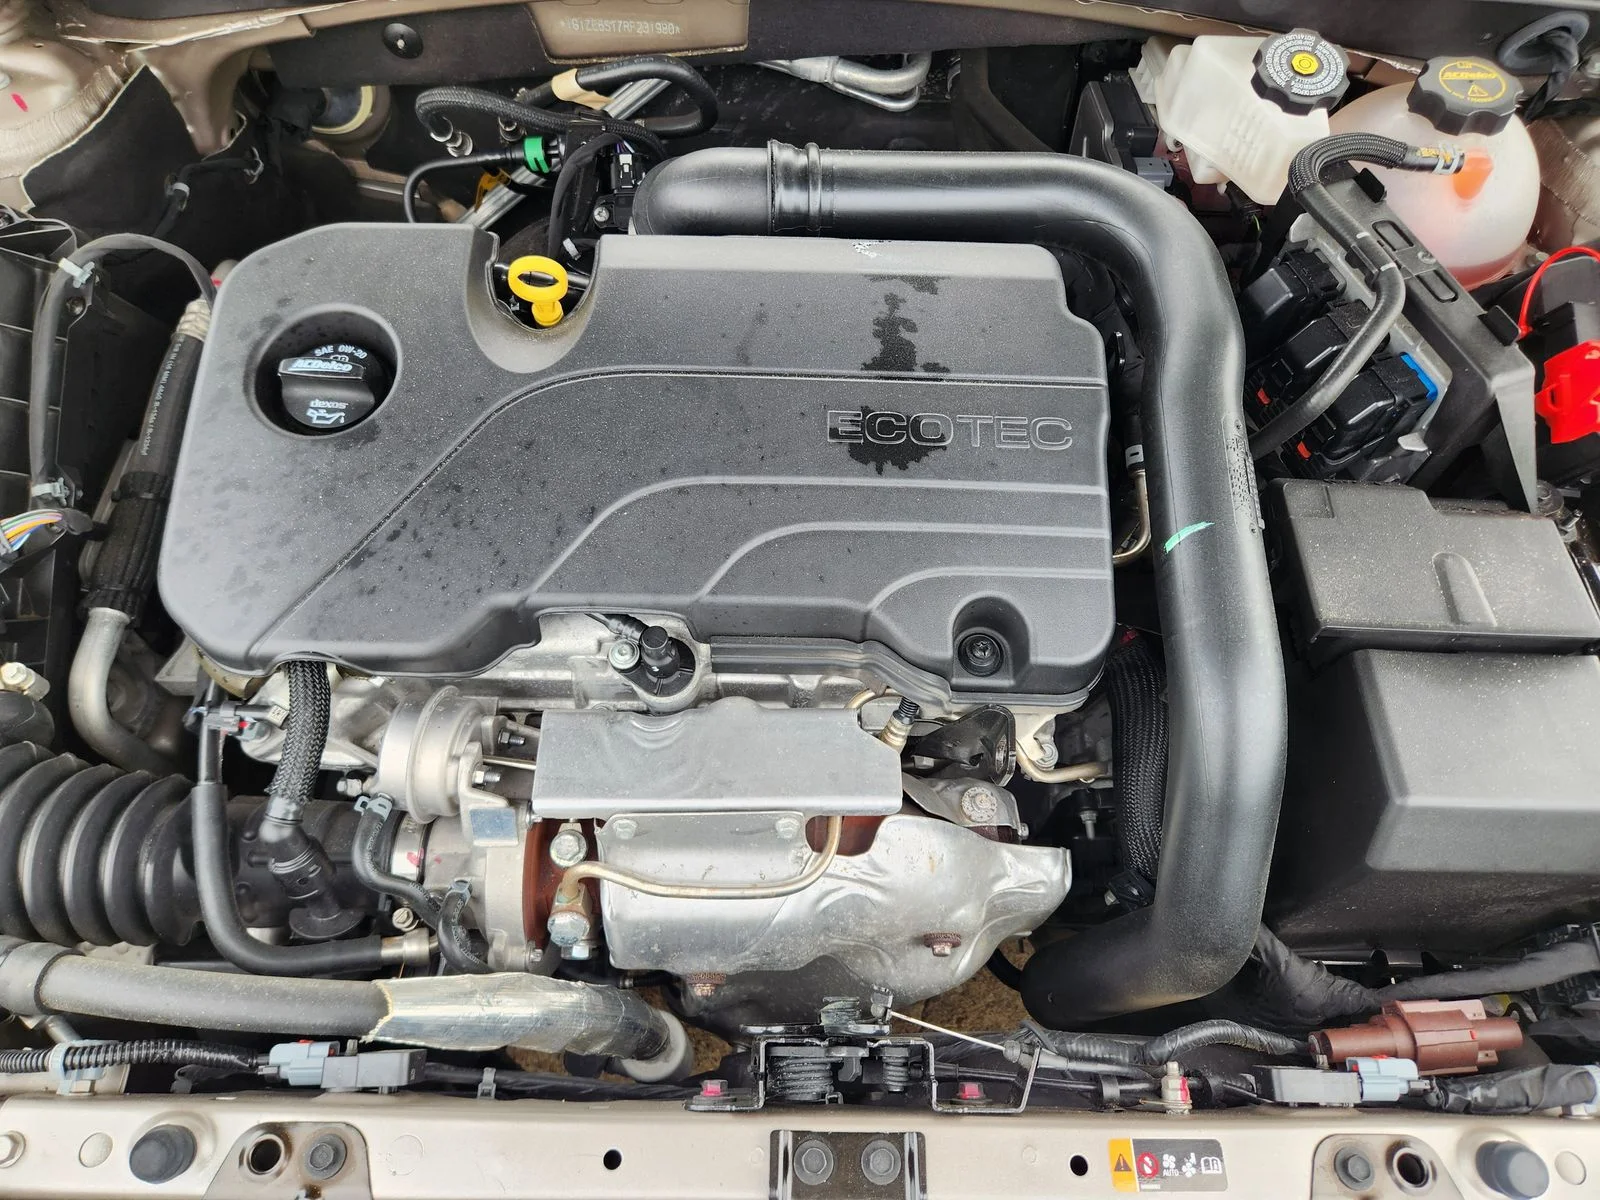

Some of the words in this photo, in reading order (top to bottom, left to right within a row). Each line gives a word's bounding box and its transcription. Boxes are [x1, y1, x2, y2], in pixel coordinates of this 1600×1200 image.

[314, 345, 334, 357] SAE
[310, 398, 347, 409] dexos
[827, 410, 1073, 450] ECOTEC
[1163, 1168, 1180, 1177] AUTO
